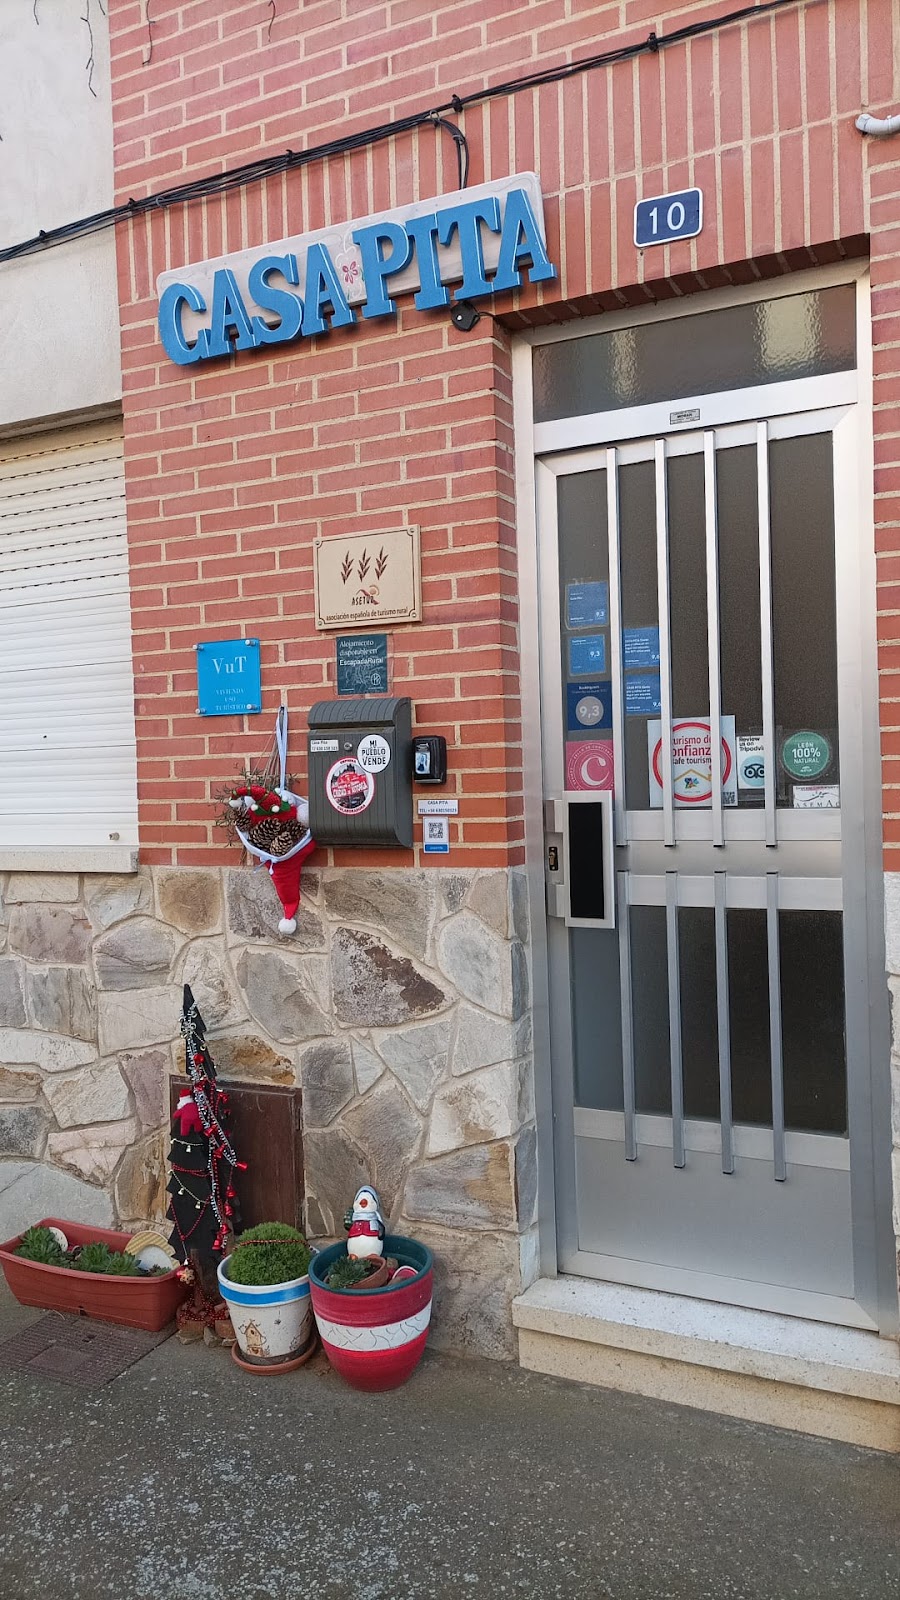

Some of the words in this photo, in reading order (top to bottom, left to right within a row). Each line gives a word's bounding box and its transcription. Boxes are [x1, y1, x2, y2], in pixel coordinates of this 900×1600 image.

[648, 200, 686, 236] 10
[158, 243, 356, 366] CASA
[352, 188, 558, 318] PITA
[350, 610, 370, 620] española
[371, 609, 377, 617] de
[377, 608, 396, 616] turismo
[397, 606, 408, 614] rural
[212, 656, 247, 674] VuT
[339, 657, 384, 667] EscapadaRural
[579, 705, 600, 719] 9,3
[673, 735, 701, 745] urismo
[361, 748, 386, 756] PUEBLO
[673, 745, 711, 757] onfianz
[792, 747, 821, 758] 100%
[362, 757, 386, 766] VENDE
